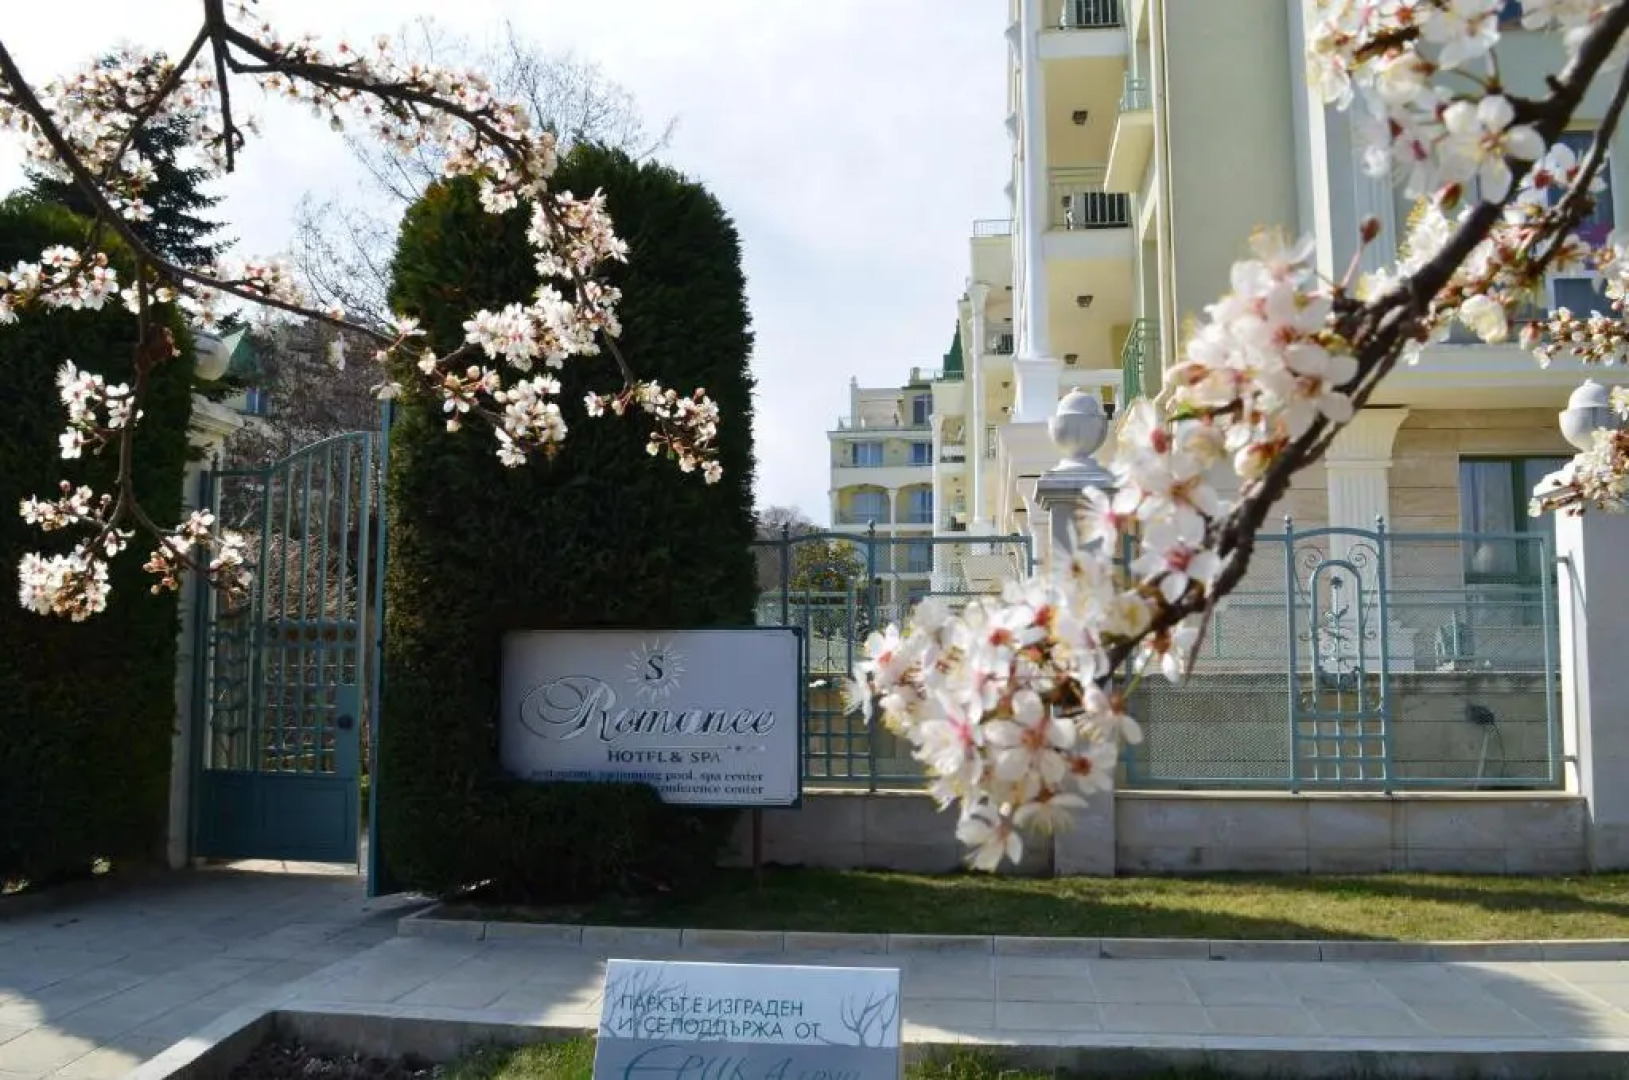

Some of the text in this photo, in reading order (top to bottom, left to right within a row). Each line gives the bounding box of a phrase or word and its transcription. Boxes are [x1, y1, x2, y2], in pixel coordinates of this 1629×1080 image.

[520, 675, 776, 742] Romance
[669, 750, 682, 763] &
[690, 750, 721, 763] SPA
[700, 772, 723, 784] spa
[724, 773, 764, 783] center
[723, 784, 764, 795] center
[621, 994, 803, 1018] ПАРКЪТ Е ИЗГРАДЕН
[618, 1015, 633, 1031] И
[670, 1017, 784, 1038] ПОДДЪРЖА
[794, 1022, 822, 1039] ОТ
